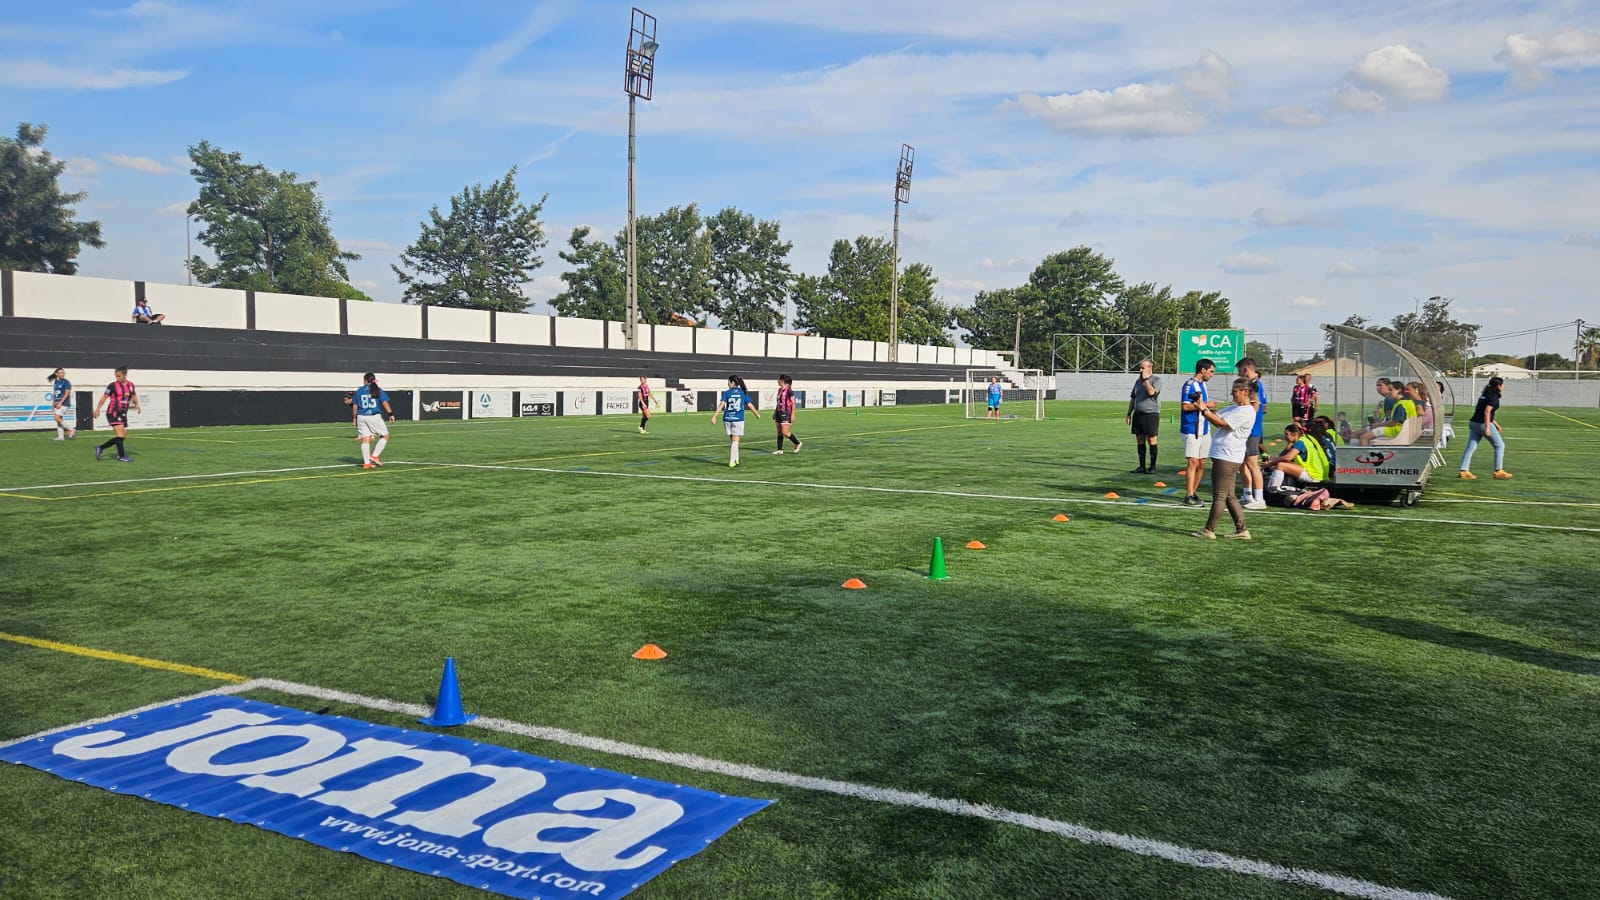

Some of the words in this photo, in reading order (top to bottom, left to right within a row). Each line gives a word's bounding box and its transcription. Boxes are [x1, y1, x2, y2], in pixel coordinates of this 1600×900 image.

[1210, 334, 1232, 348] CA
[360, 394, 377, 409] 83
[606, 402, 629, 410] PACHECO
[727, 397, 742, 411] 24
[1336, 467, 1374, 475] SPORTS
[1375, 468, 1420, 476] PARTNER
[319, 814, 606, 896] www.joma-sport.com
